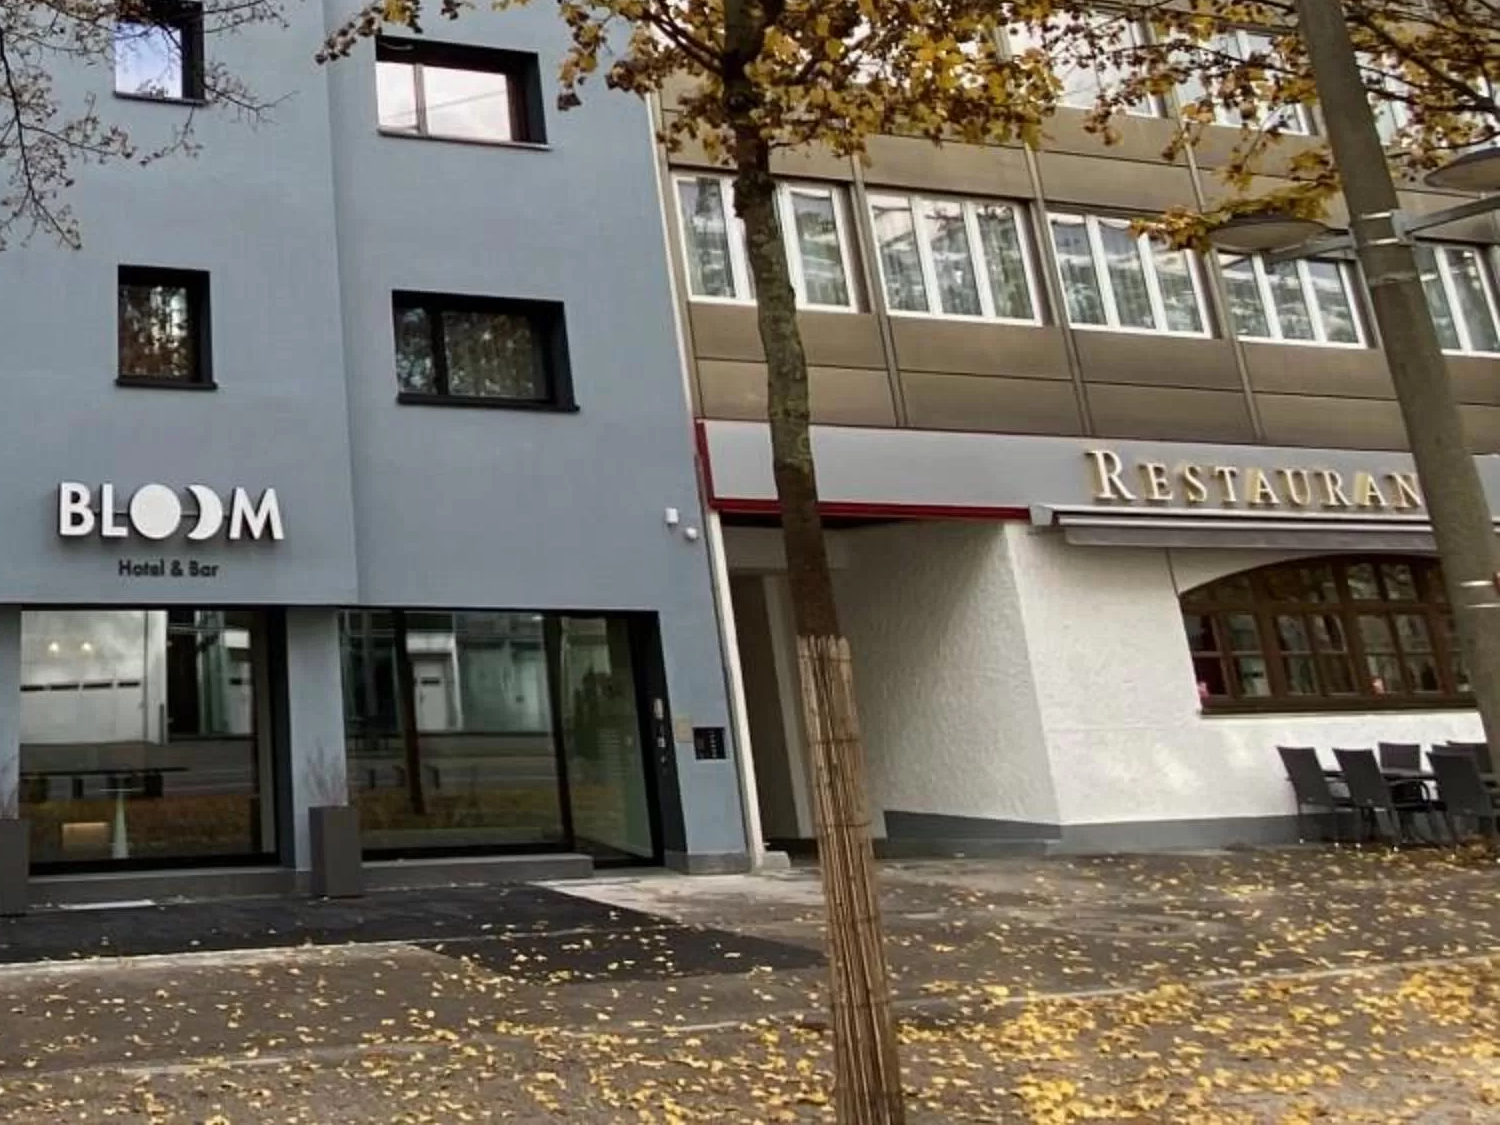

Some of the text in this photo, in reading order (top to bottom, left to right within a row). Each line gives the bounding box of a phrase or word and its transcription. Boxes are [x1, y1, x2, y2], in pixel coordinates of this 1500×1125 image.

[1083, 448, 1423, 510] RESTAURAN
[58, 481, 285, 541] BLOOM
[118, 558, 220, 578] Hotel & Bar
